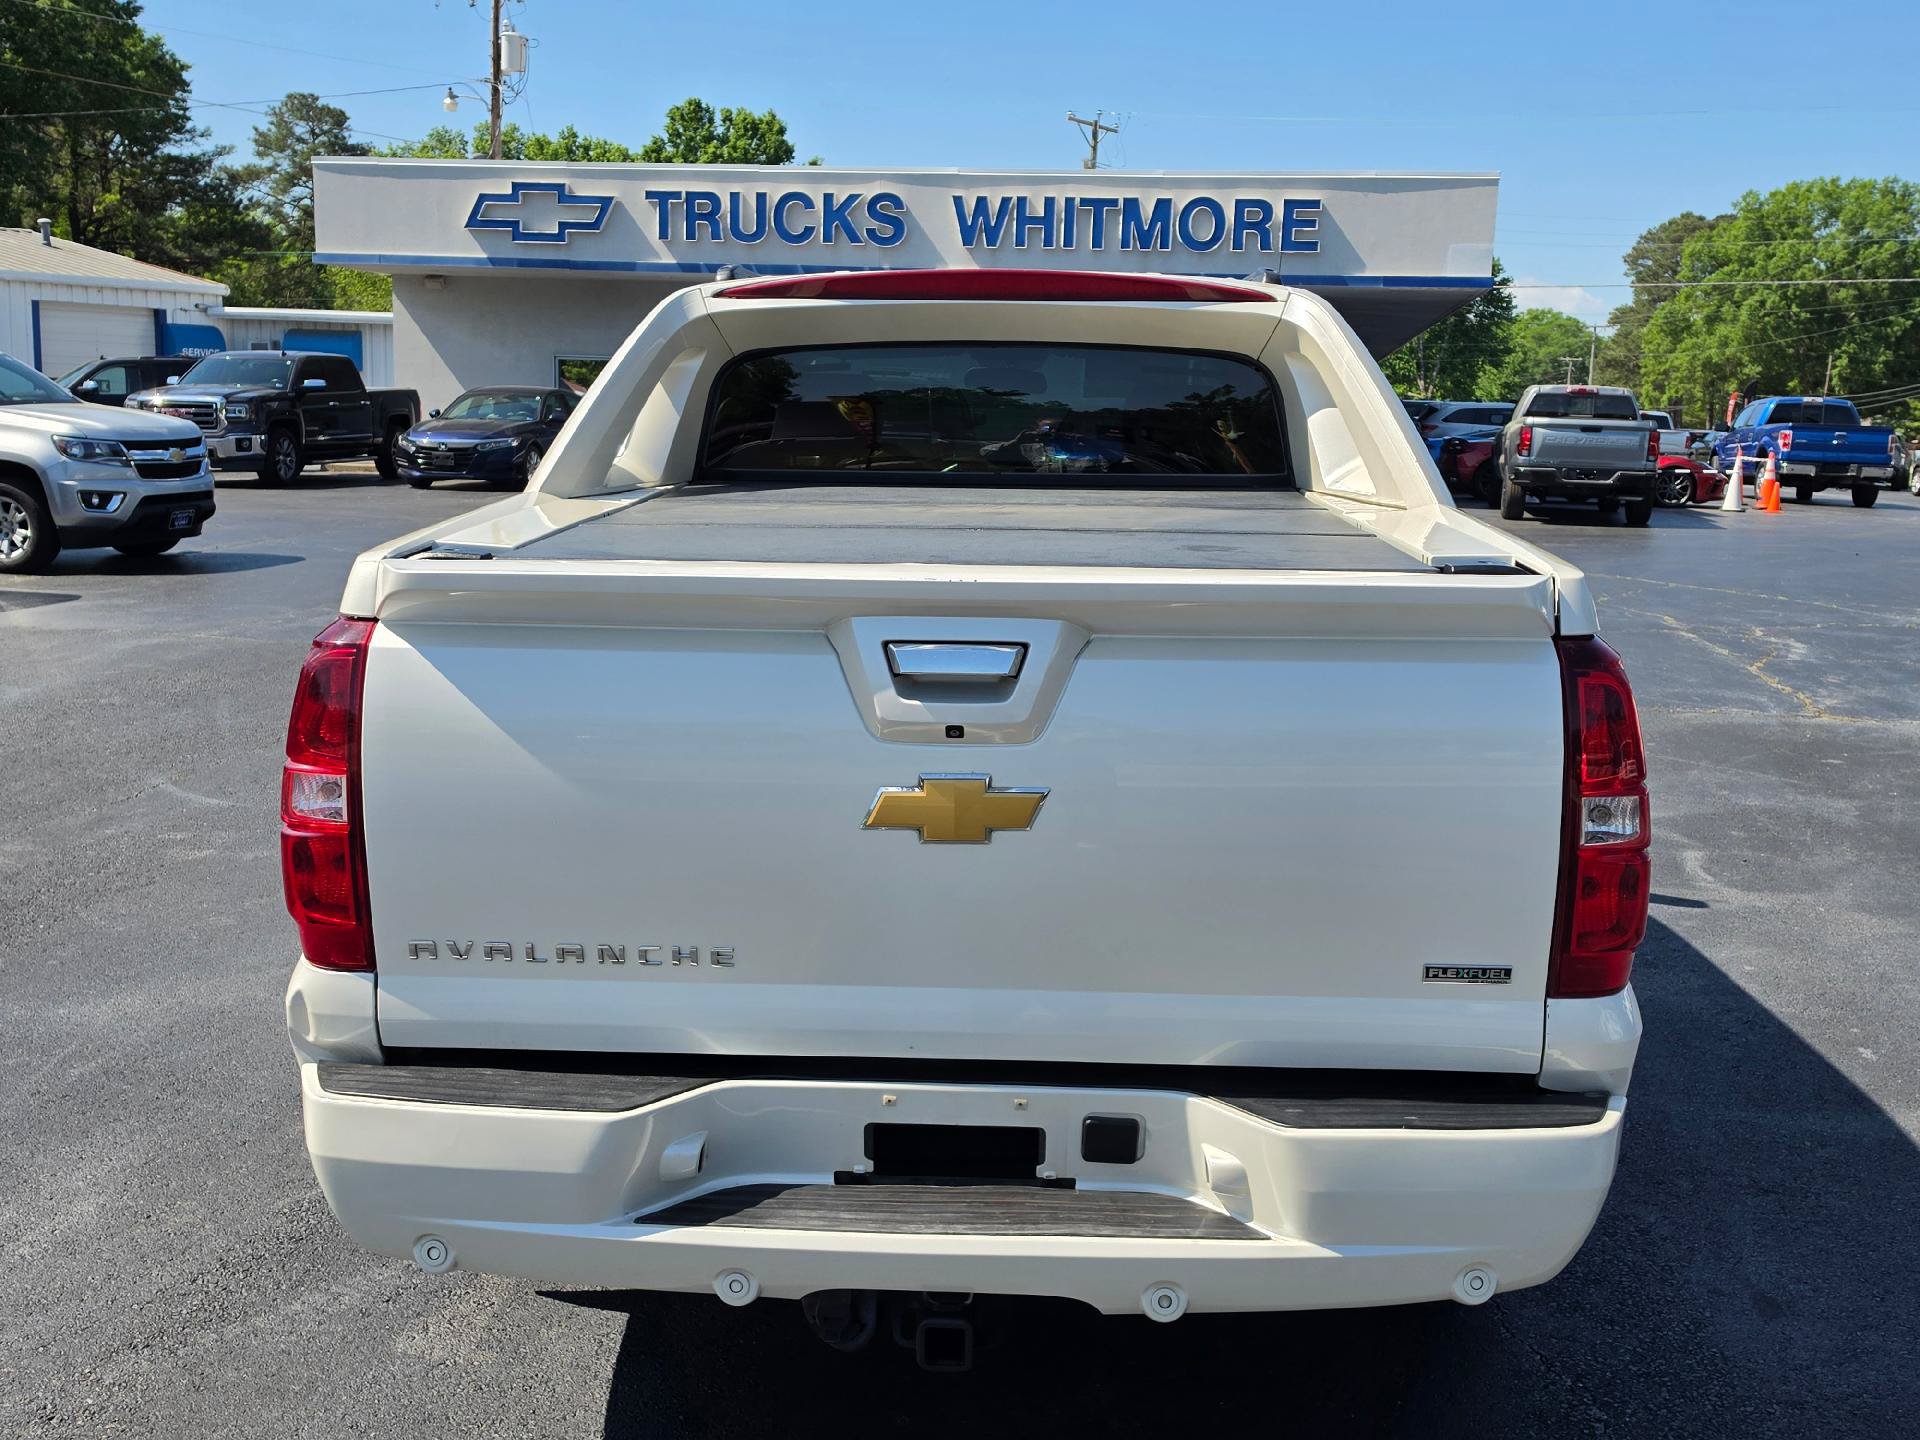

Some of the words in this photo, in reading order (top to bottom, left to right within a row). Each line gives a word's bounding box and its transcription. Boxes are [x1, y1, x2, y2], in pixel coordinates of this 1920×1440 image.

[645, 190, 906, 247] TRUCKS
[952, 195, 1322, 253] WHITMORE
[408, 939, 735, 968] AVALANCHE
[1428, 968, 1510, 979] FLEXFUEL
